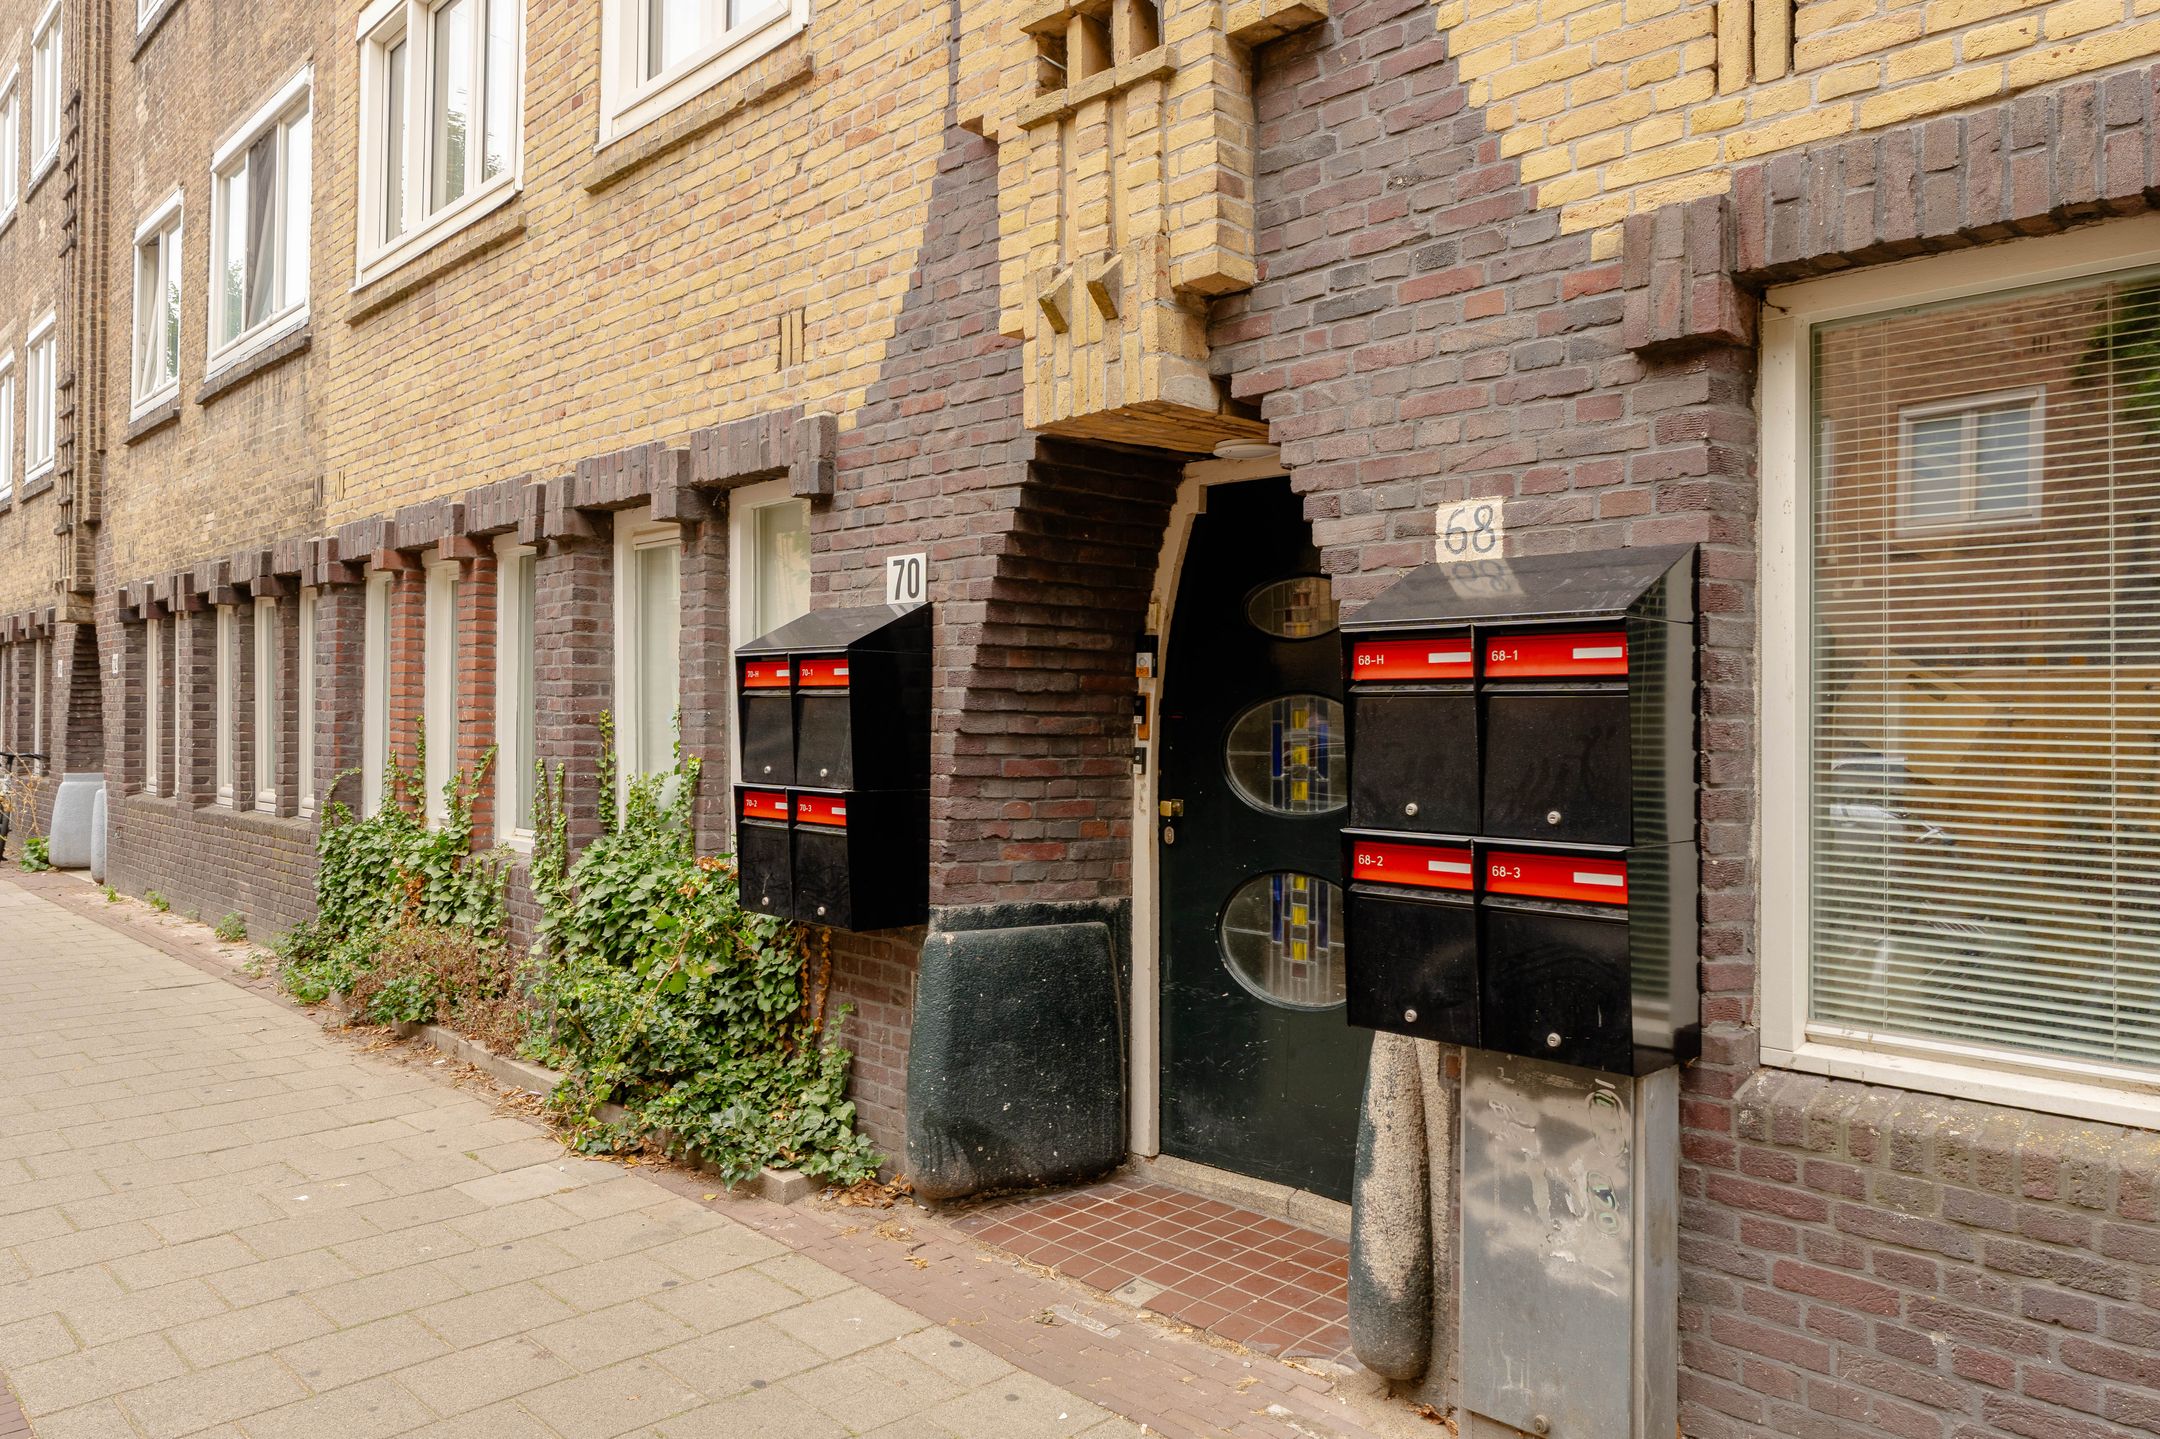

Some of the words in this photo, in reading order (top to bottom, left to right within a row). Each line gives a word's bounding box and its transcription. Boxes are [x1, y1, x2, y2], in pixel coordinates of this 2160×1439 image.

[1444, 505, 1496, 554] 68
[893, 557, 920, 600] 70
[1358, 654, 1384, 665] 68-H
[1491, 649, 1518, 661] 68-1
[747, 670, 760, 678] 70-H
[801, 668, 814, 677] 70-1
[746, 799, 758, 808] 70-2
[800, 803, 813, 812] 70-3
[1358, 854, 1384, 867] 68-2
[1491, 865, 1521, 878] 68-3
